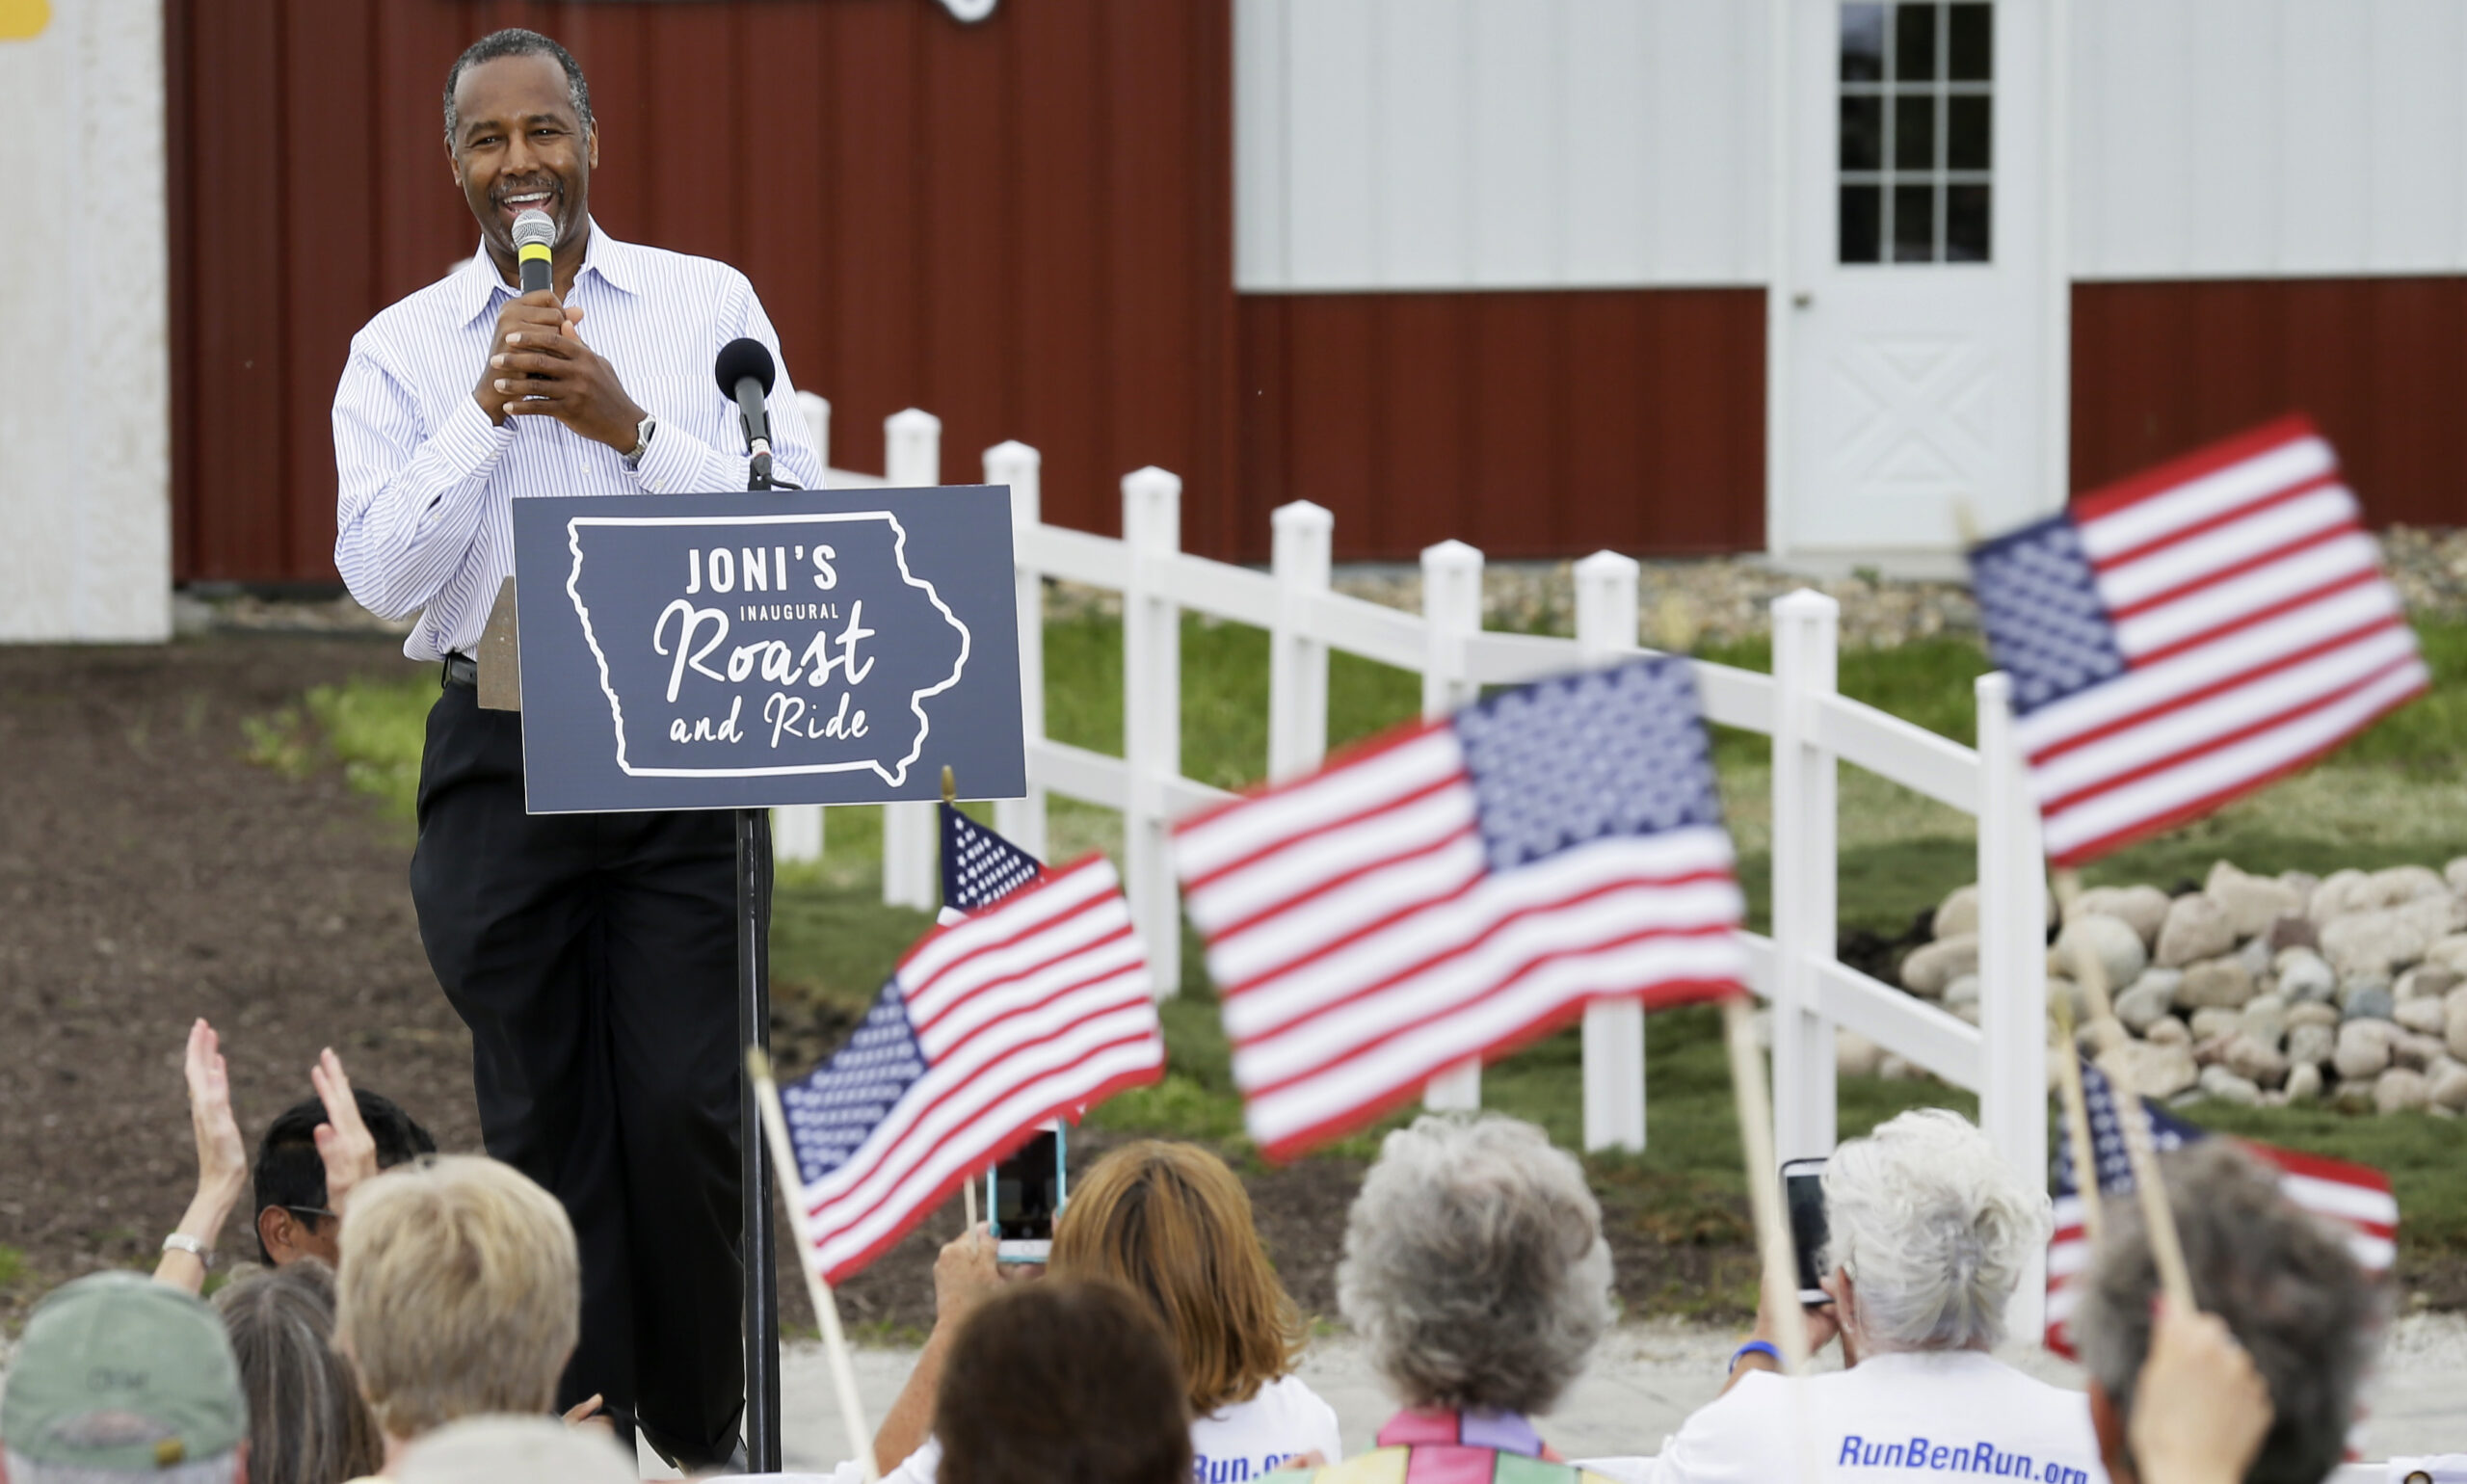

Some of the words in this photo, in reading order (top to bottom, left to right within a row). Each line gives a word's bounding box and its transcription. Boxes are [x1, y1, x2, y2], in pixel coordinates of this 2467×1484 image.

[685, 544, 837, 595] JONI'S
[739, 602, 840, 623] INAUGURAL
[652, 598, 876, 702] Roast
[669, 695, 744, 744] and
[763, 691, 869, 749] Ride
